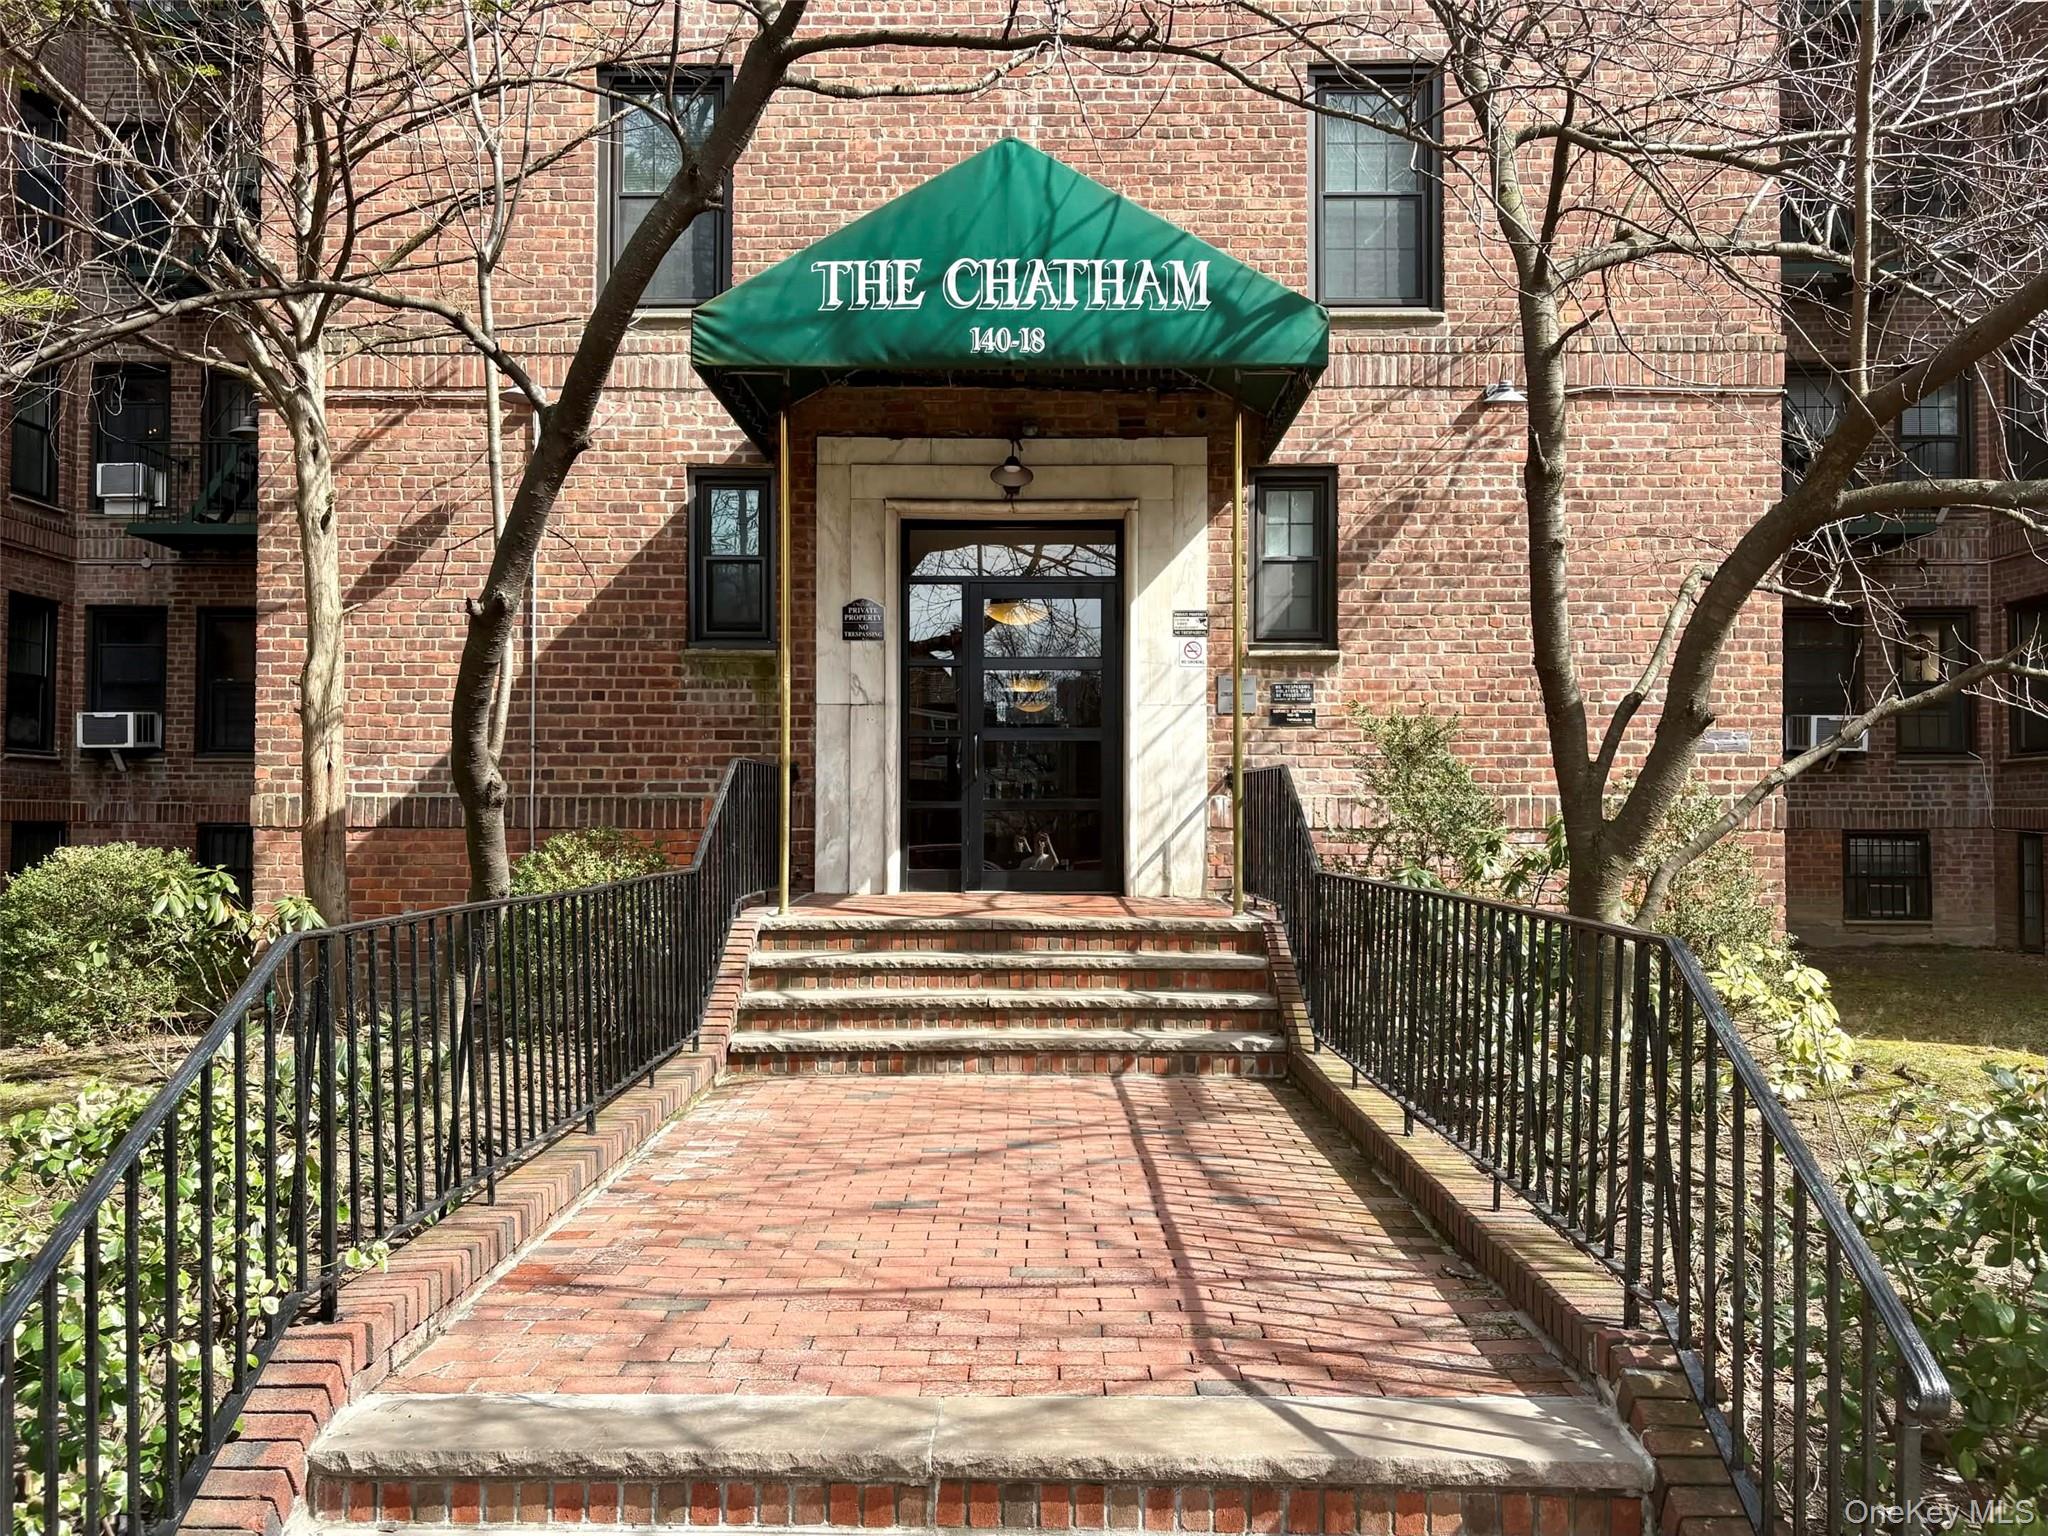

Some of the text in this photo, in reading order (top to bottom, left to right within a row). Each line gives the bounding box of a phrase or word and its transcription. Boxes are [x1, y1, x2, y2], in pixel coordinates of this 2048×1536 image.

[811, 257, 1212, 311] THE CHATHAM
[969, 326, 1046, 354] 140-18
